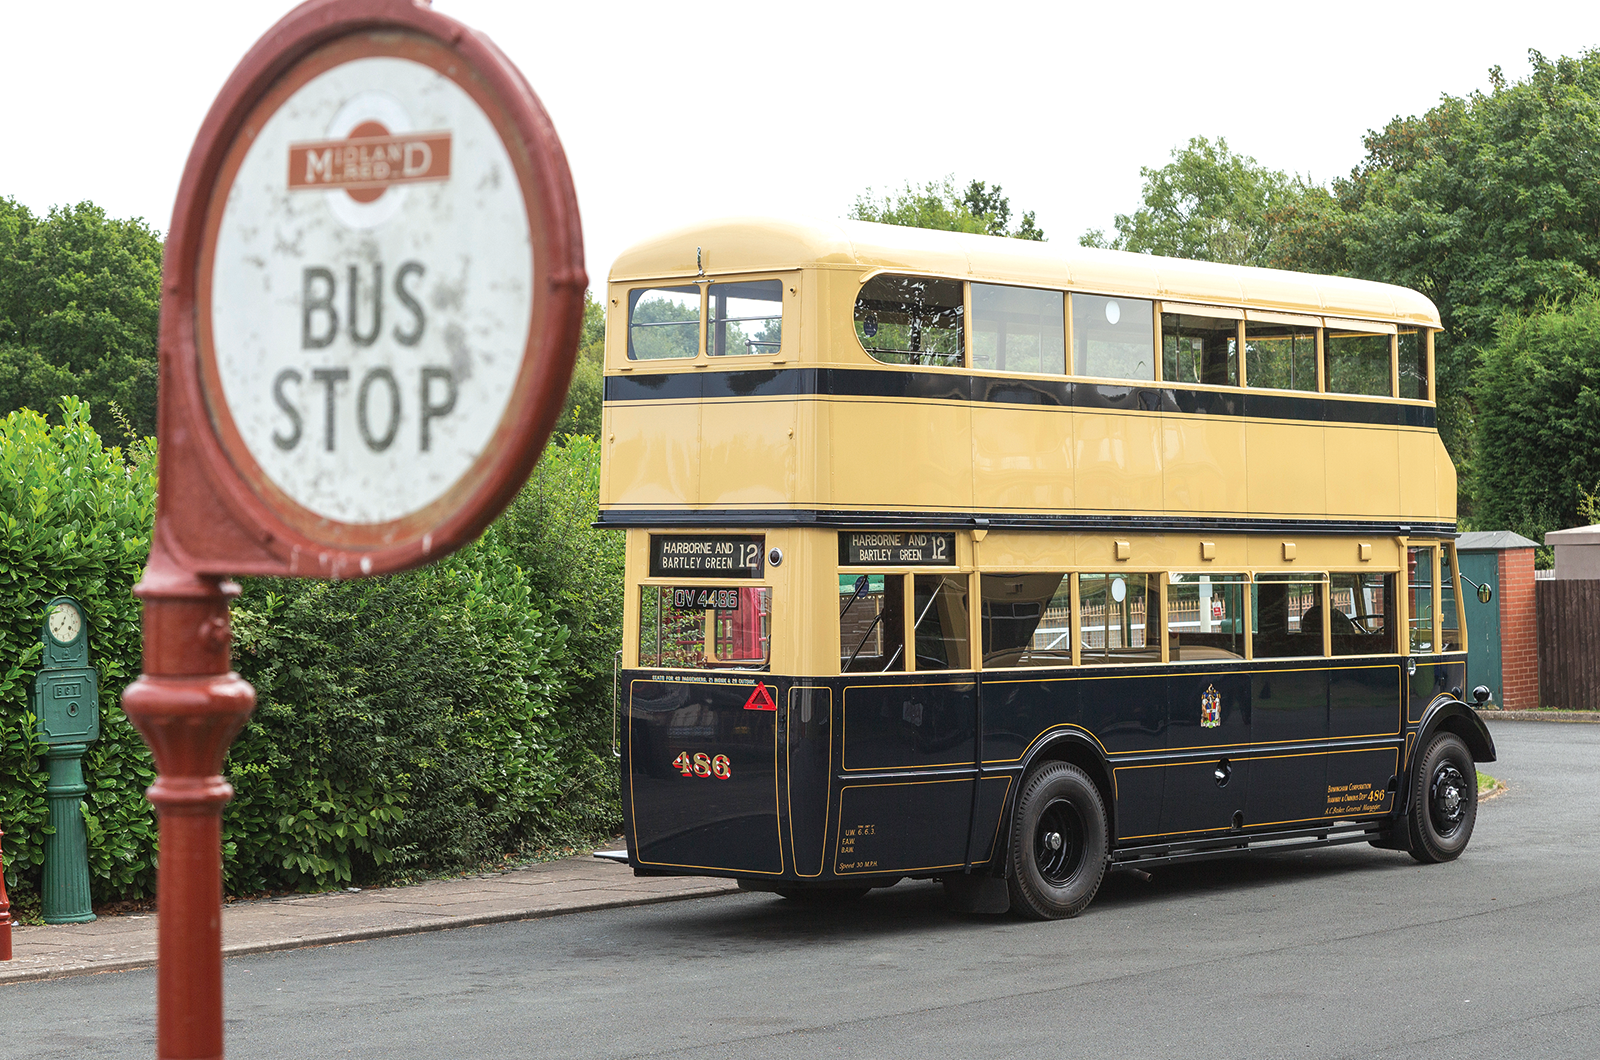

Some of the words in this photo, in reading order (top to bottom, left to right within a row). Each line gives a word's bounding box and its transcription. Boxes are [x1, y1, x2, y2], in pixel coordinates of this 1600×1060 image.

[305, 141, 433, 184] MIDLAND
[343, 161, 391, 180] RED
[301, 259, 427, 350] BUS
[271, 365, 460, 452] STOP
[663, 542, 712, 554] HARBORNE
[714, 542, 734, 554] AND
[852, 534, 901, 546] HARBORNE
[908, 534, 928, 546] AND
[932, 536, 946, 560] 12
[662, 556, 702, 569] BARTLEY
[705, 557, 733, 569] GREEN
[739, 544, 758, 568] 12
[859, 549, 892, 561] BARTLEY
[899, 549, 922, 561] GREEN
[674, 589, 696, 607] OV
[697, 589, 738, 608] 4486
[672, 751, 732, 780] 486
[1367, 789, 1385, 802] 486
[839, 862, 855, 872] Speed
